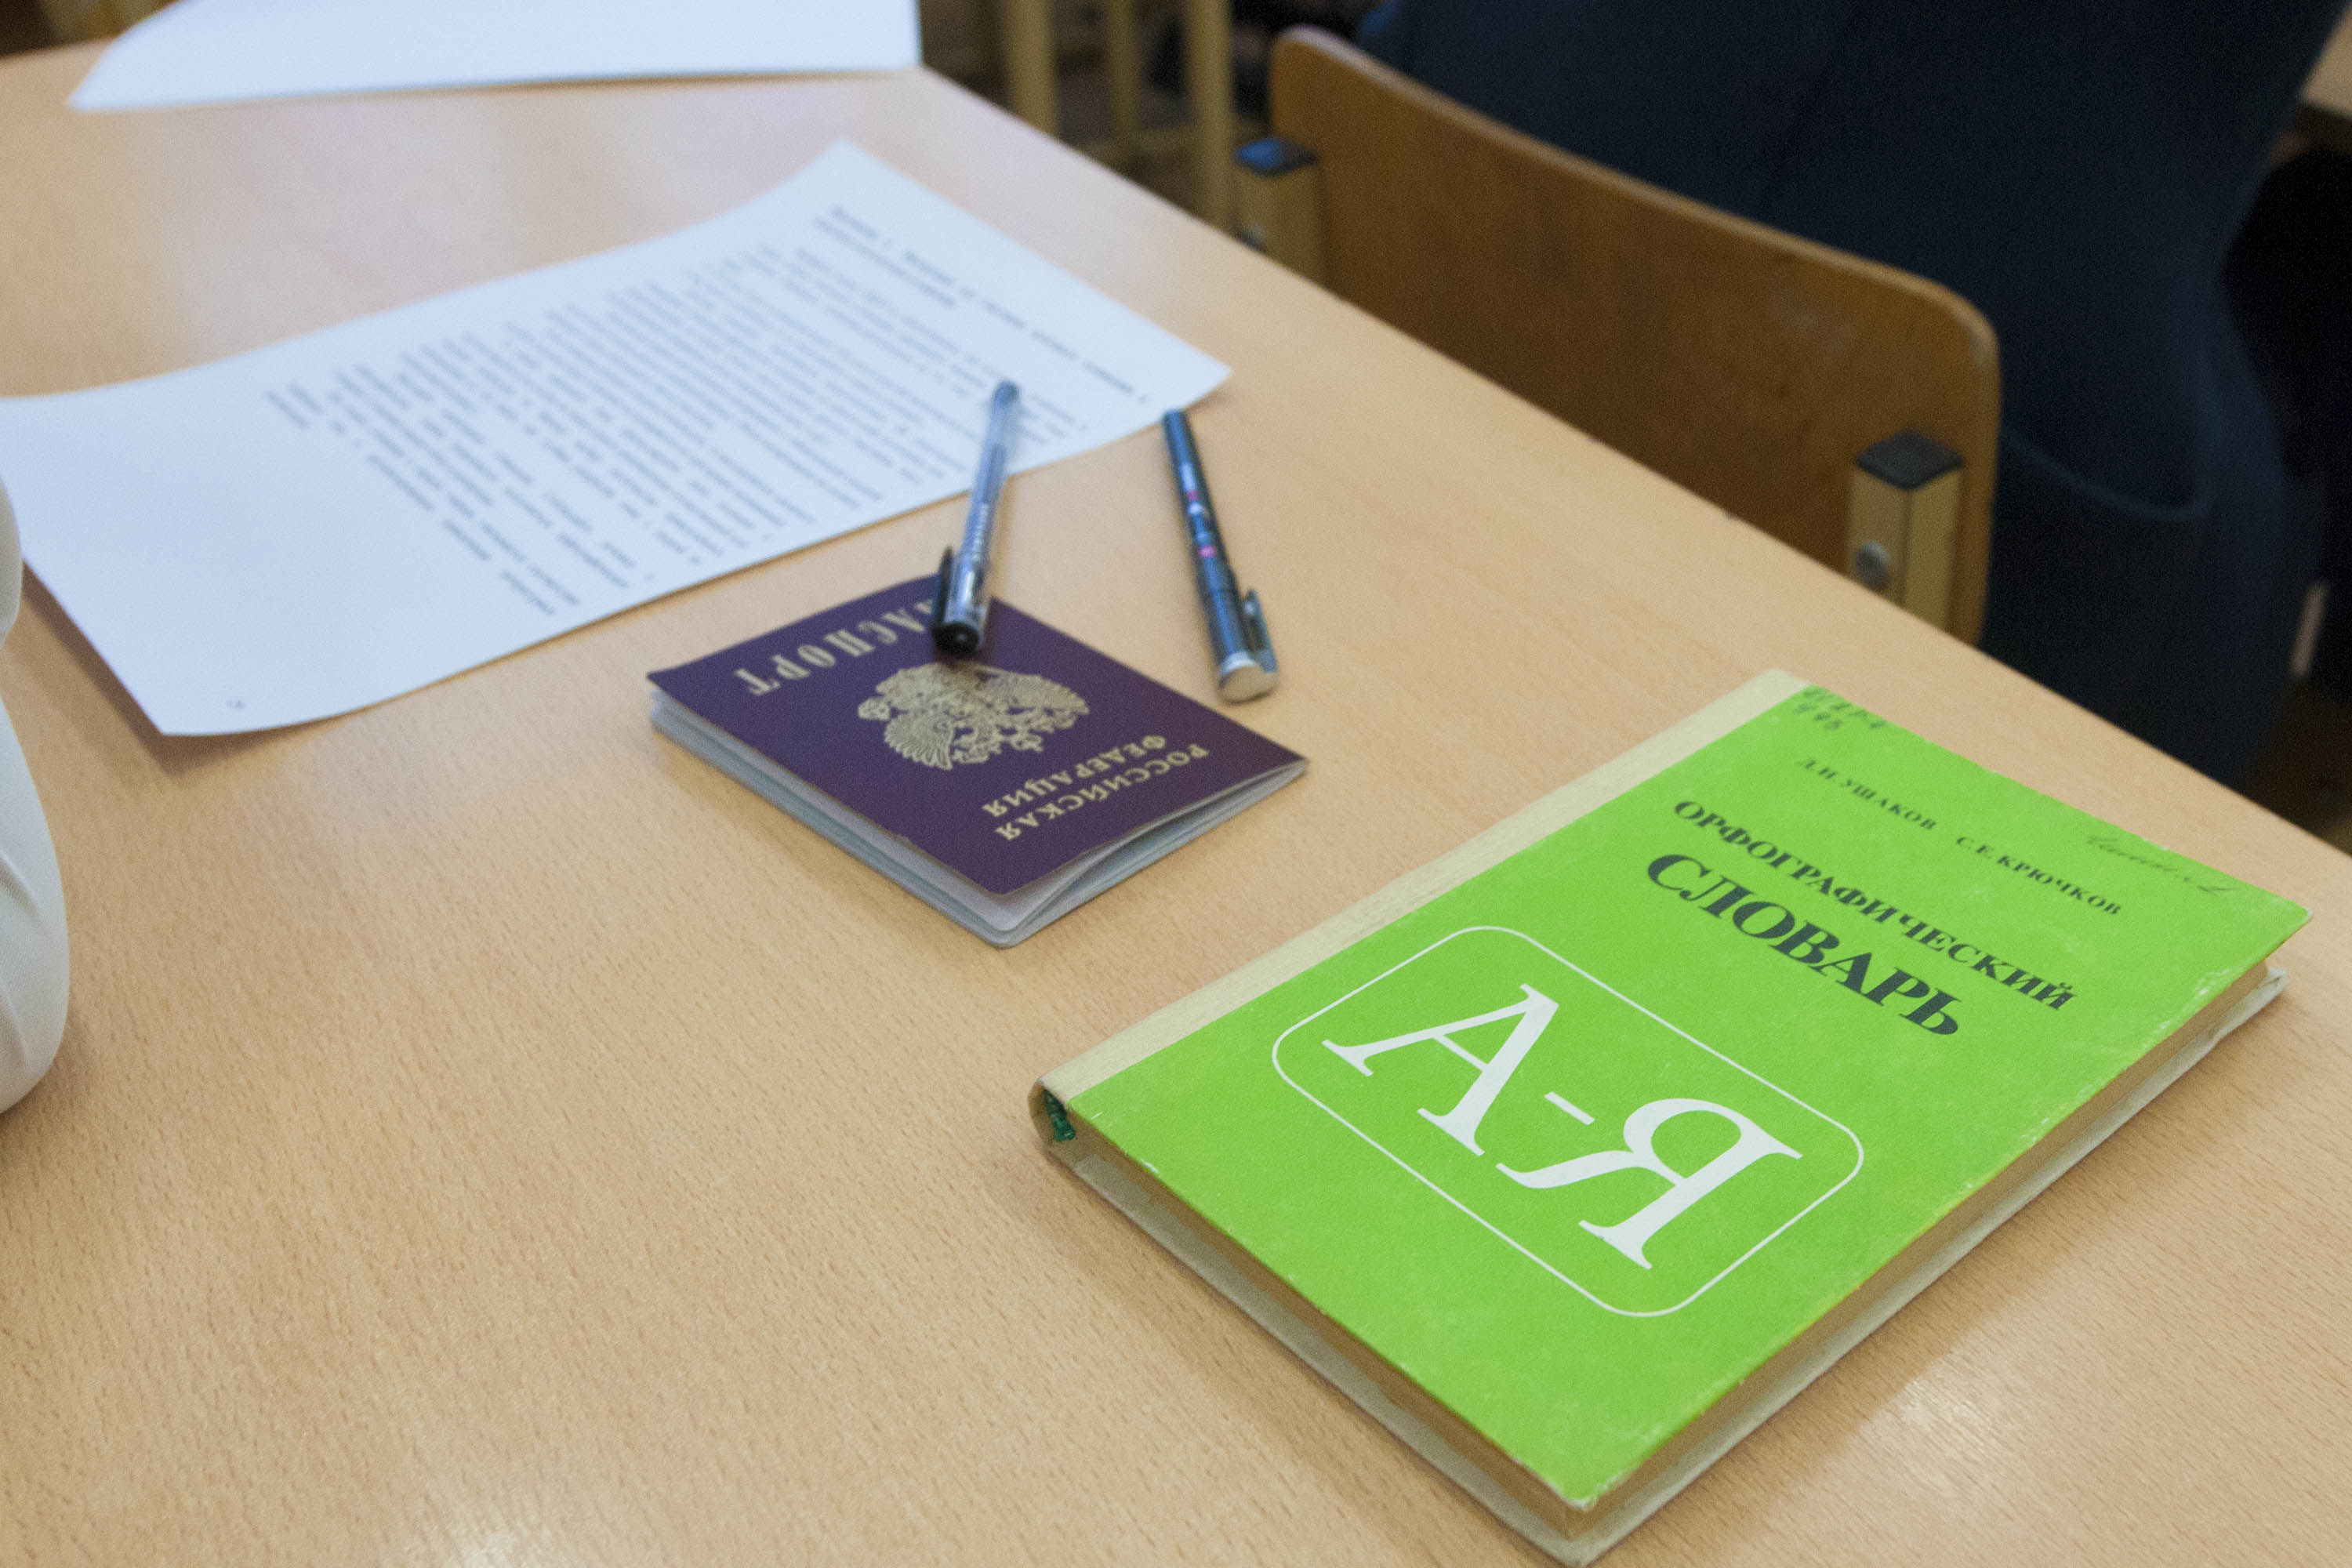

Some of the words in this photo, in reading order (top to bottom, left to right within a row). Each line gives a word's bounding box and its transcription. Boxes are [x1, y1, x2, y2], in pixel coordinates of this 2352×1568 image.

[735, 598, 933, 695] АСПОРТ
[982, 735, 1167, 817] ФЕДЕРАЦИЯ
[996, 744, 1209, 840] РОССИЙСКАЯ
[1647, 854, 1960, 1036] СЛОВАРЬ
[1674, 800, 2078, 1011] ОРФОГРАФИЧЕСКИЙ
[1322, 984, 1802, 1269] А-Я
